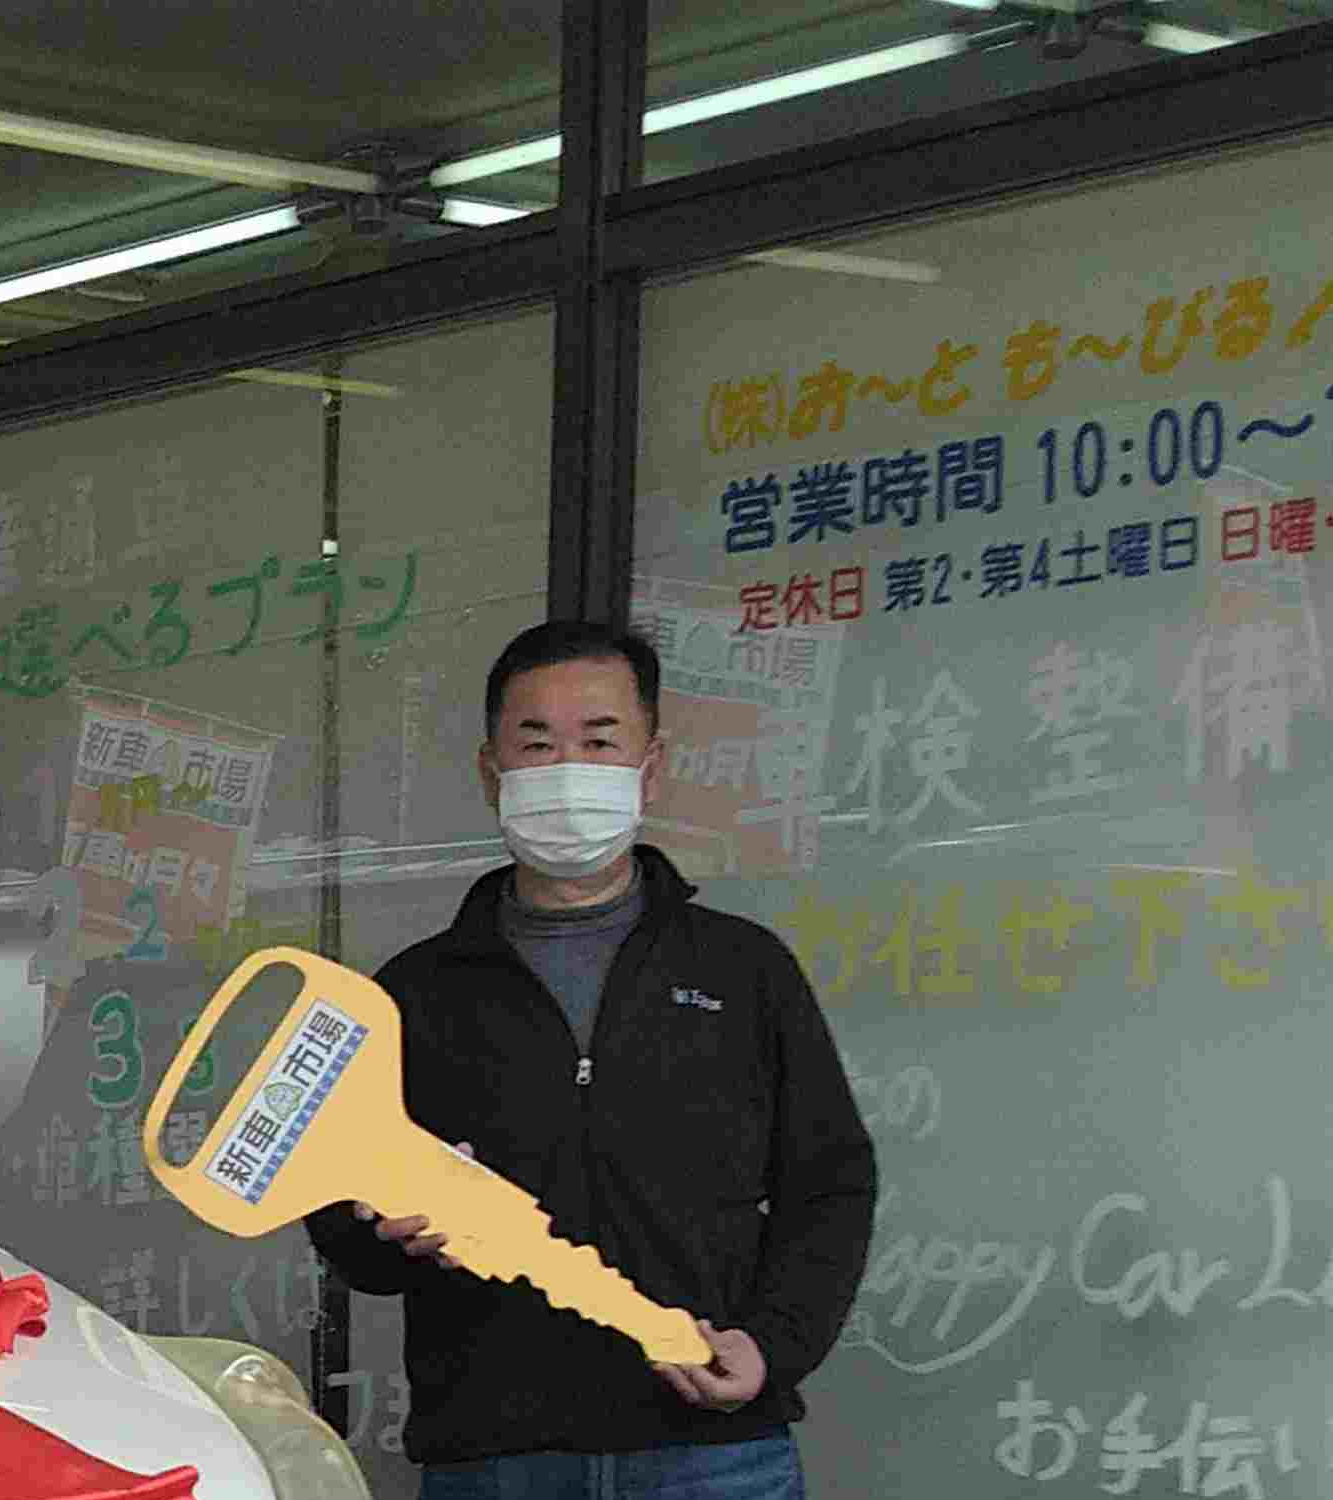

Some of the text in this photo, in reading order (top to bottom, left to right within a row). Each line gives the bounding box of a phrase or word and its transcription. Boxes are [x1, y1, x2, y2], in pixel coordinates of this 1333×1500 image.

[719, 383, 1333, 556] 営業時間 10:00〜
[737, 567, 865, 634] 定休日
[883, 515, 1201, 614] 第2・第4土曜日
[785, 876, 1333, 1000] お任せ下さ
[839, 1172, 1333, 1376] appy Car L
